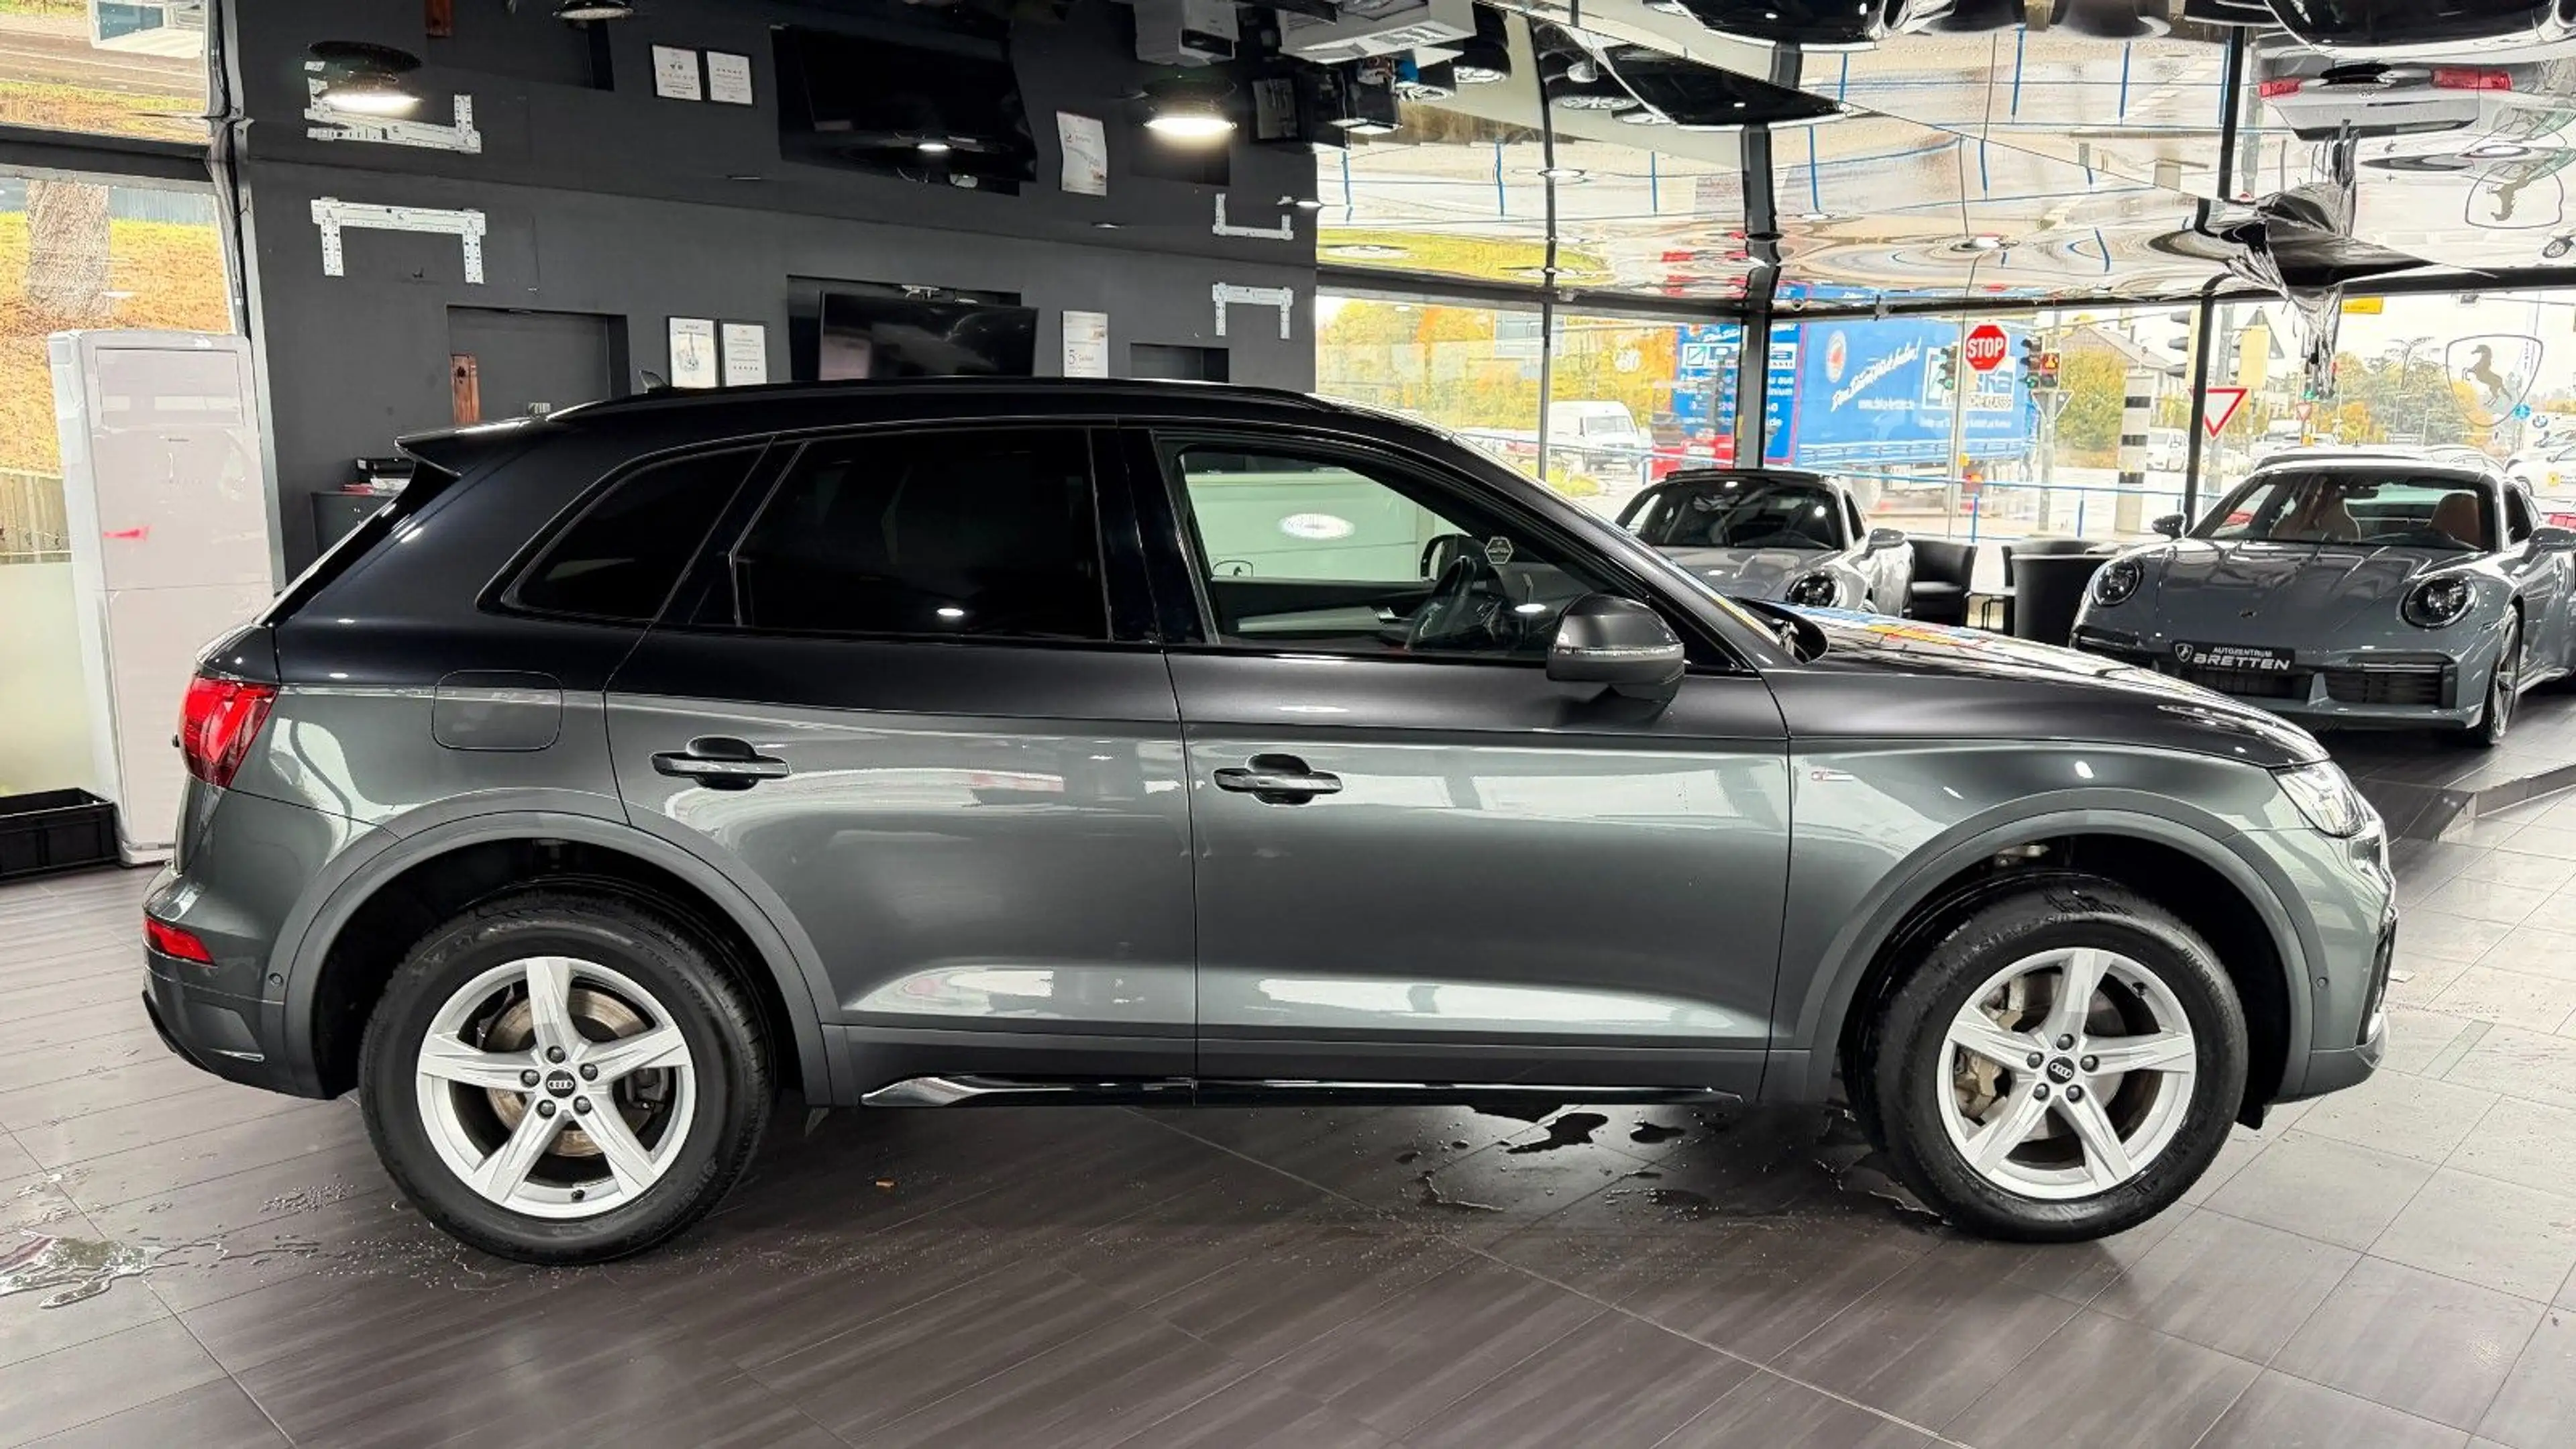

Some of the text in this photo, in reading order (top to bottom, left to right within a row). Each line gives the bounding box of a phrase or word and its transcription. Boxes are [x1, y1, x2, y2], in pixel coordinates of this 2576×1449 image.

[1967, 337, 2004, 359] STOP
[2193, 652, 2291, 671] BRETTEN
[2212, 646, 2273, 658] AUTOZENTRUM
